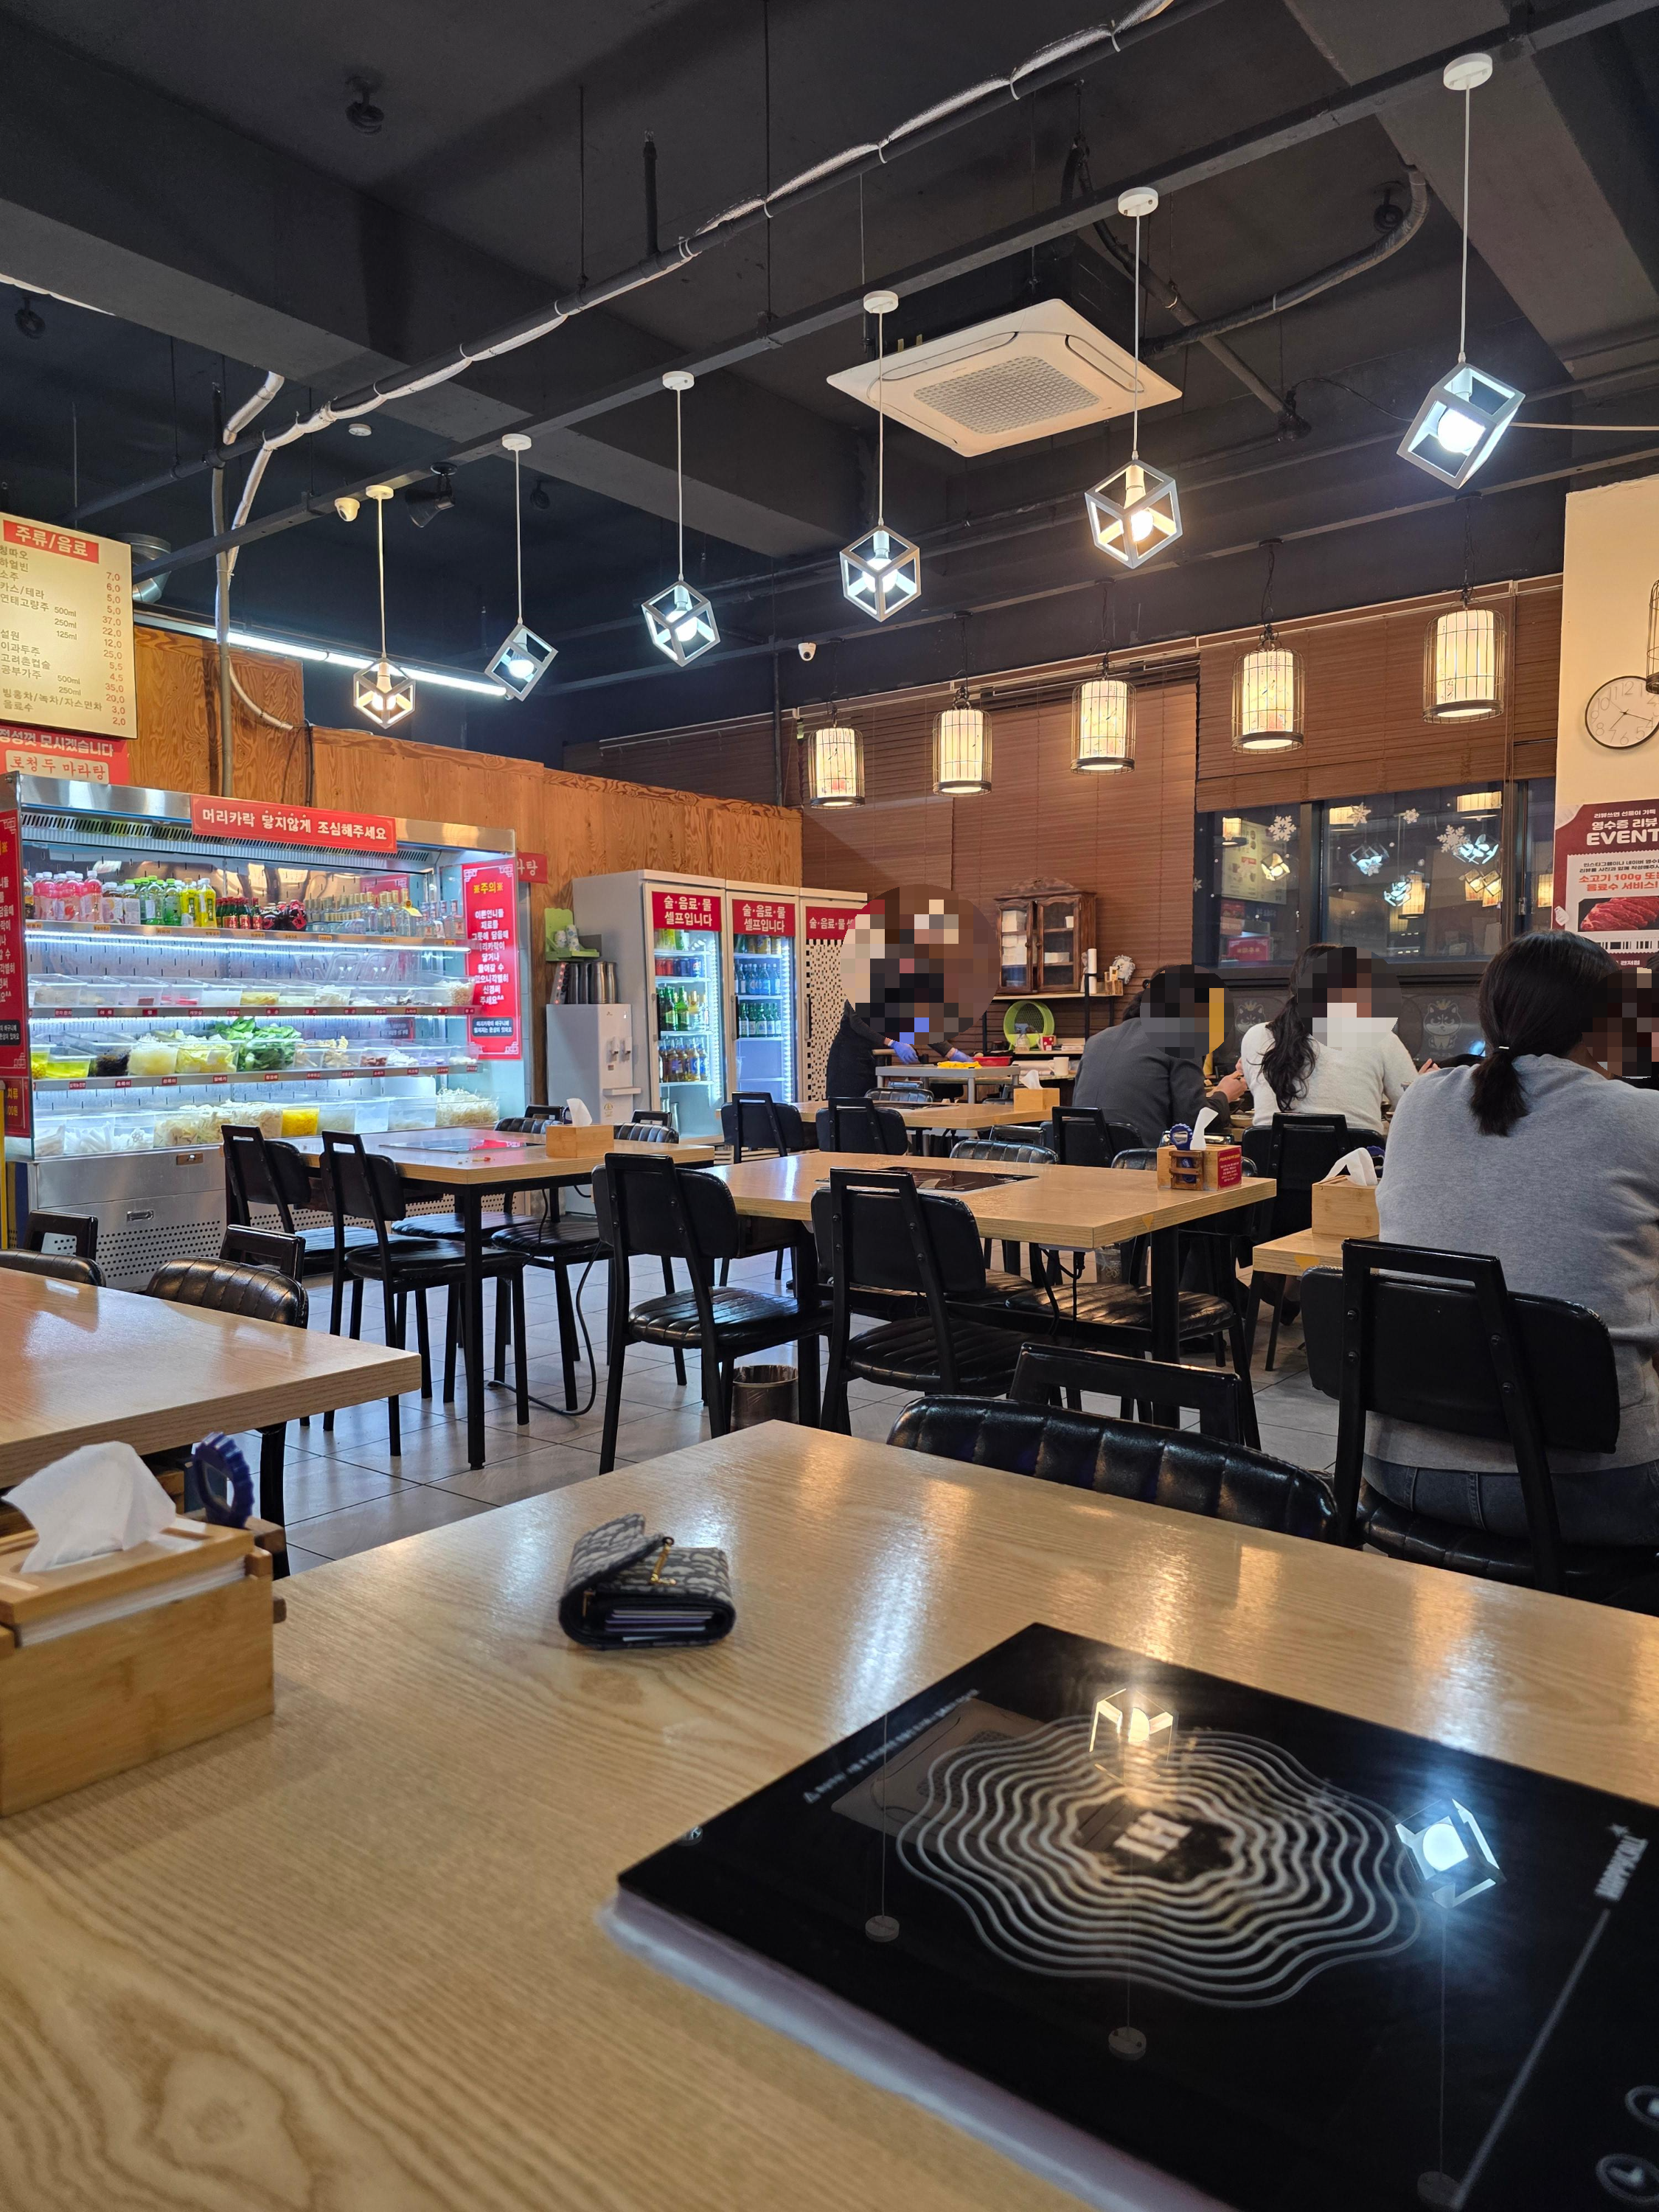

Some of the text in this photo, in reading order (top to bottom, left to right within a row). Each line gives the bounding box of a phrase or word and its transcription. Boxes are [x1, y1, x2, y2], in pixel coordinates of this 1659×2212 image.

[15, 525, 88, 557] 주류/음료
[0, 557, 28, 572] 하얼빈
[0, 570, 19, 581] 소주
[0, 582, 45, 599] 카스/테라
[0, 594, 49, 612] 연태고량주
[55, 607, 77, 617] 500ml
[55, 619, 77, 629] 250ml
[1, 629, 20, 641] 설원
[57, 630, 77, 640] 125ml
[1, 641, 41, 656] 이과두주
[1, 665, 42, 679] 공부가주
[58, 675, 80, 684] 500ml
[59, 686, 81, 696] 250ml
[1609, 686, 1617, 701] 11
[1621, 681, 1634, 696] 12
[3, 700, 34, 712] 음료수
[1597, 697, 1610, 712] 10
[1590, 710, 1599, 724] 9
[1645, 717, 1654, 728] 4
[1596, 722, 1604, 736] 8
[1609, 729, 1617, 743] 7
[1636, 726, 1645, 740] 5
[0, 728, 114, 757] 정성껏 모시겠습니다
[1620, 731, 1629, 745] 6
[63, 761, 105, 780] 마라탕
[202, 808, 387, 840] 머리카락 닿지않게 조심해주세요
[1592, 818, 1658, 830] 영수증 리뷰
[1587, 828, 1659, 846] EVENT
[1579, 874, 1610, 883] 소고기
[1614, 873, 1641, 881] 100g
[1587, 881, 1658, 891] 음료수 서비스!
[481, 919, 498, 929] 재료를
[664, 911, 713, 927] 셀프입니다
[744, 919, 785, 933] 셀프입니다
[491, 930, 509, 940] 담을때
[498, 963, 504, 973] 수
